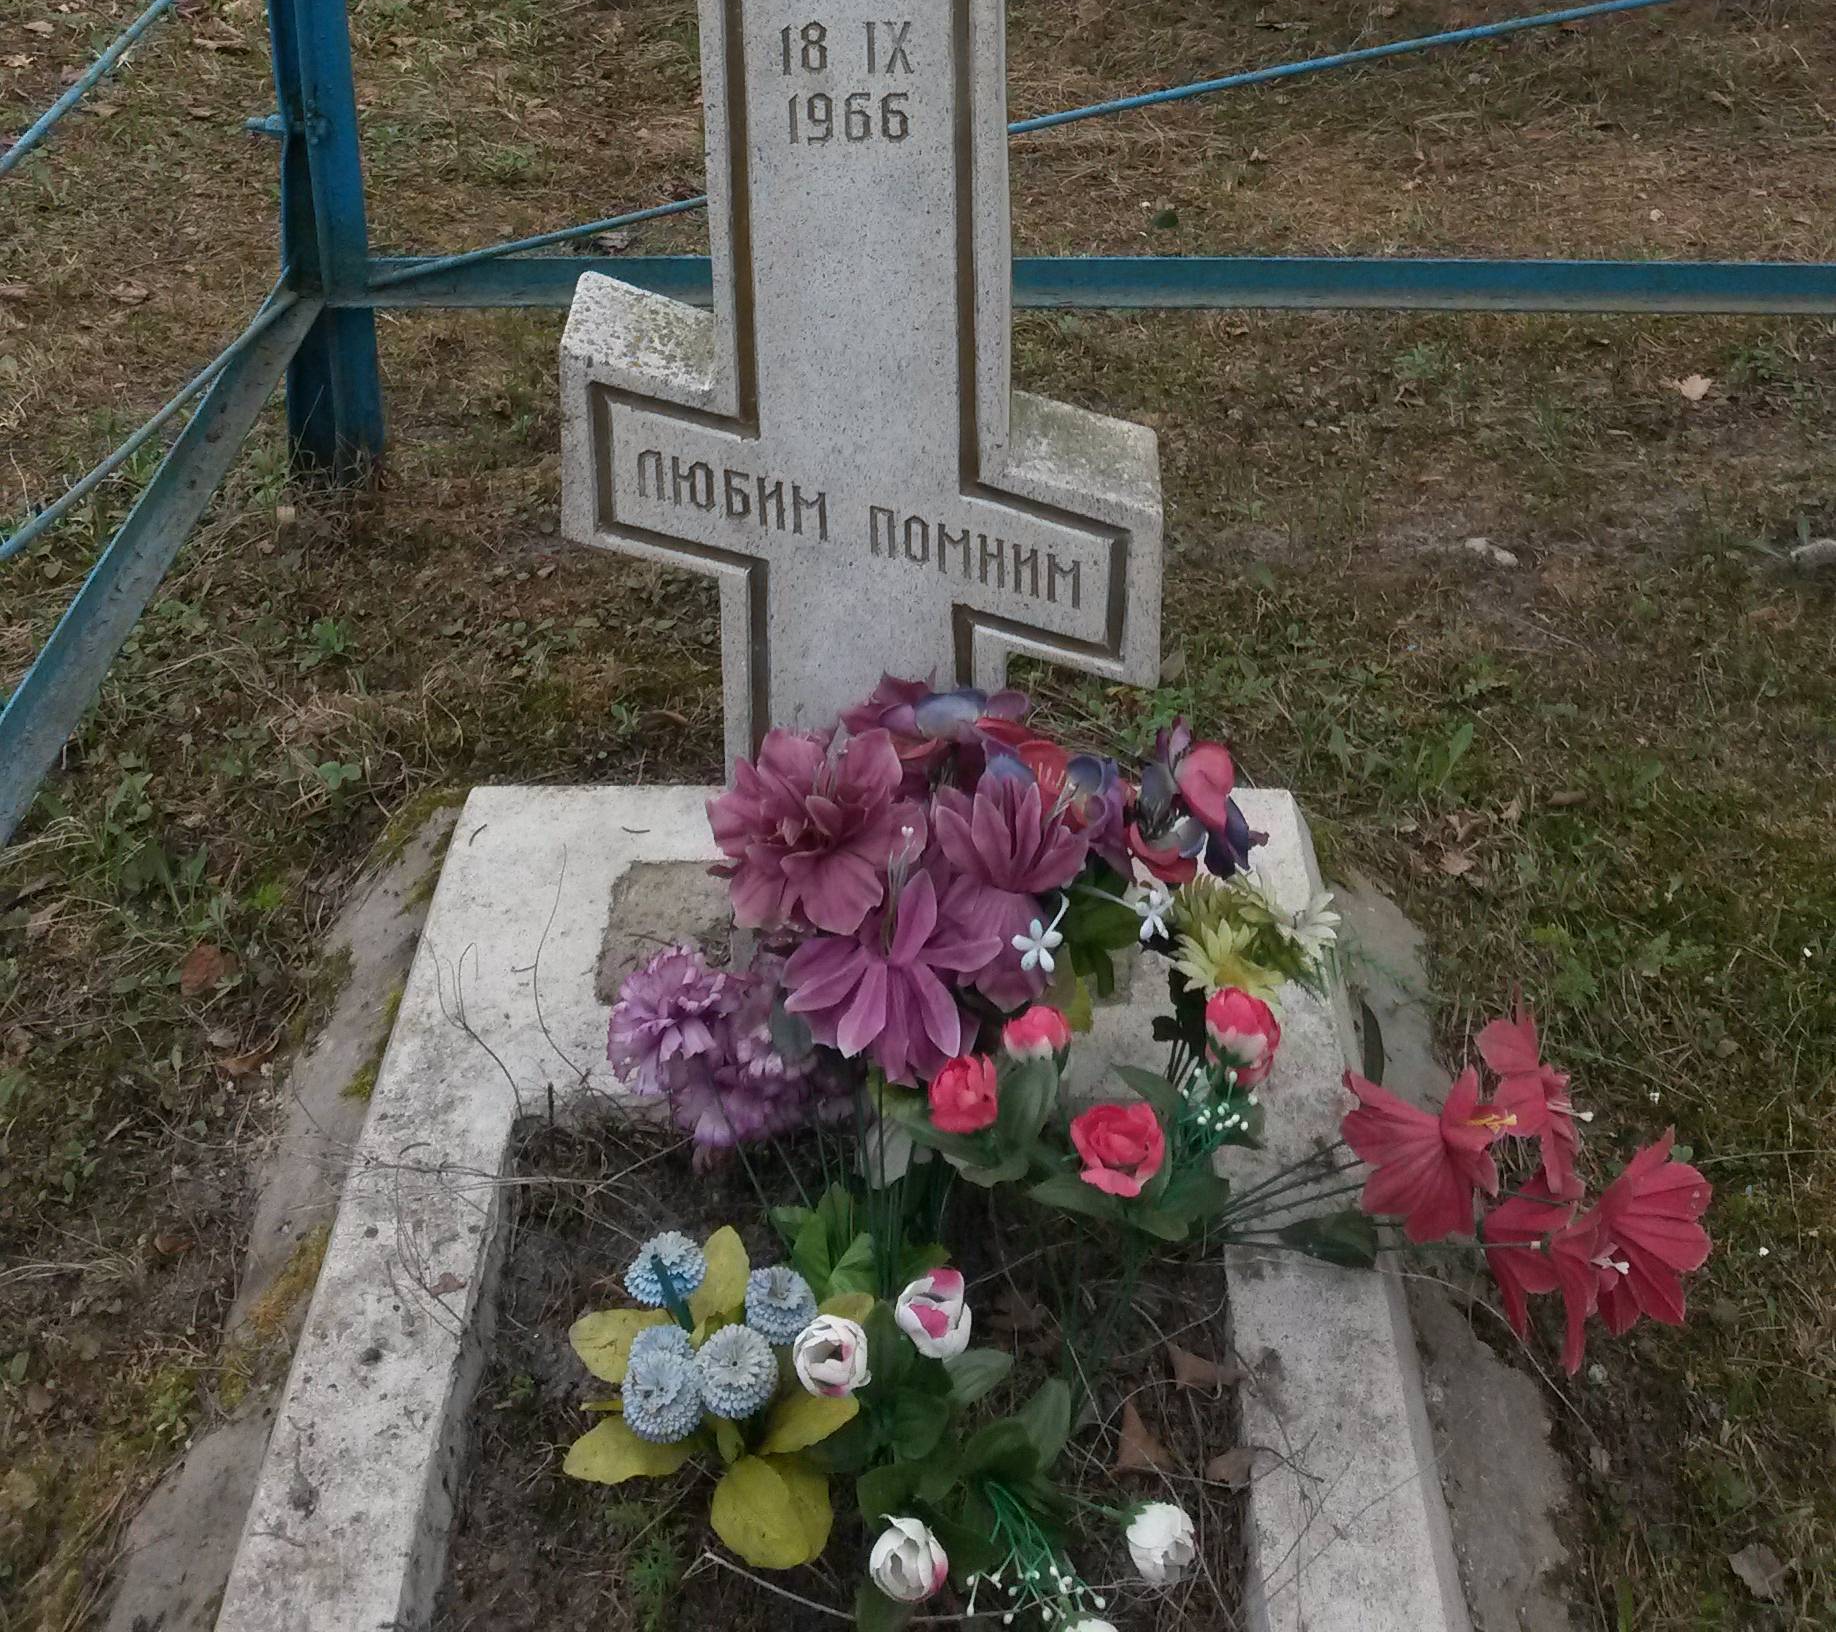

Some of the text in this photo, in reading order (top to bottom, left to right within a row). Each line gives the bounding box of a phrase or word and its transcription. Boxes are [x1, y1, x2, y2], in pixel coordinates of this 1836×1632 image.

[779, 20, 914, 76] 18 IX
[788, 92, 910, 146] 1966
[636, 449, 1082, 610] ЛЮБИМ ПОМНИМ
